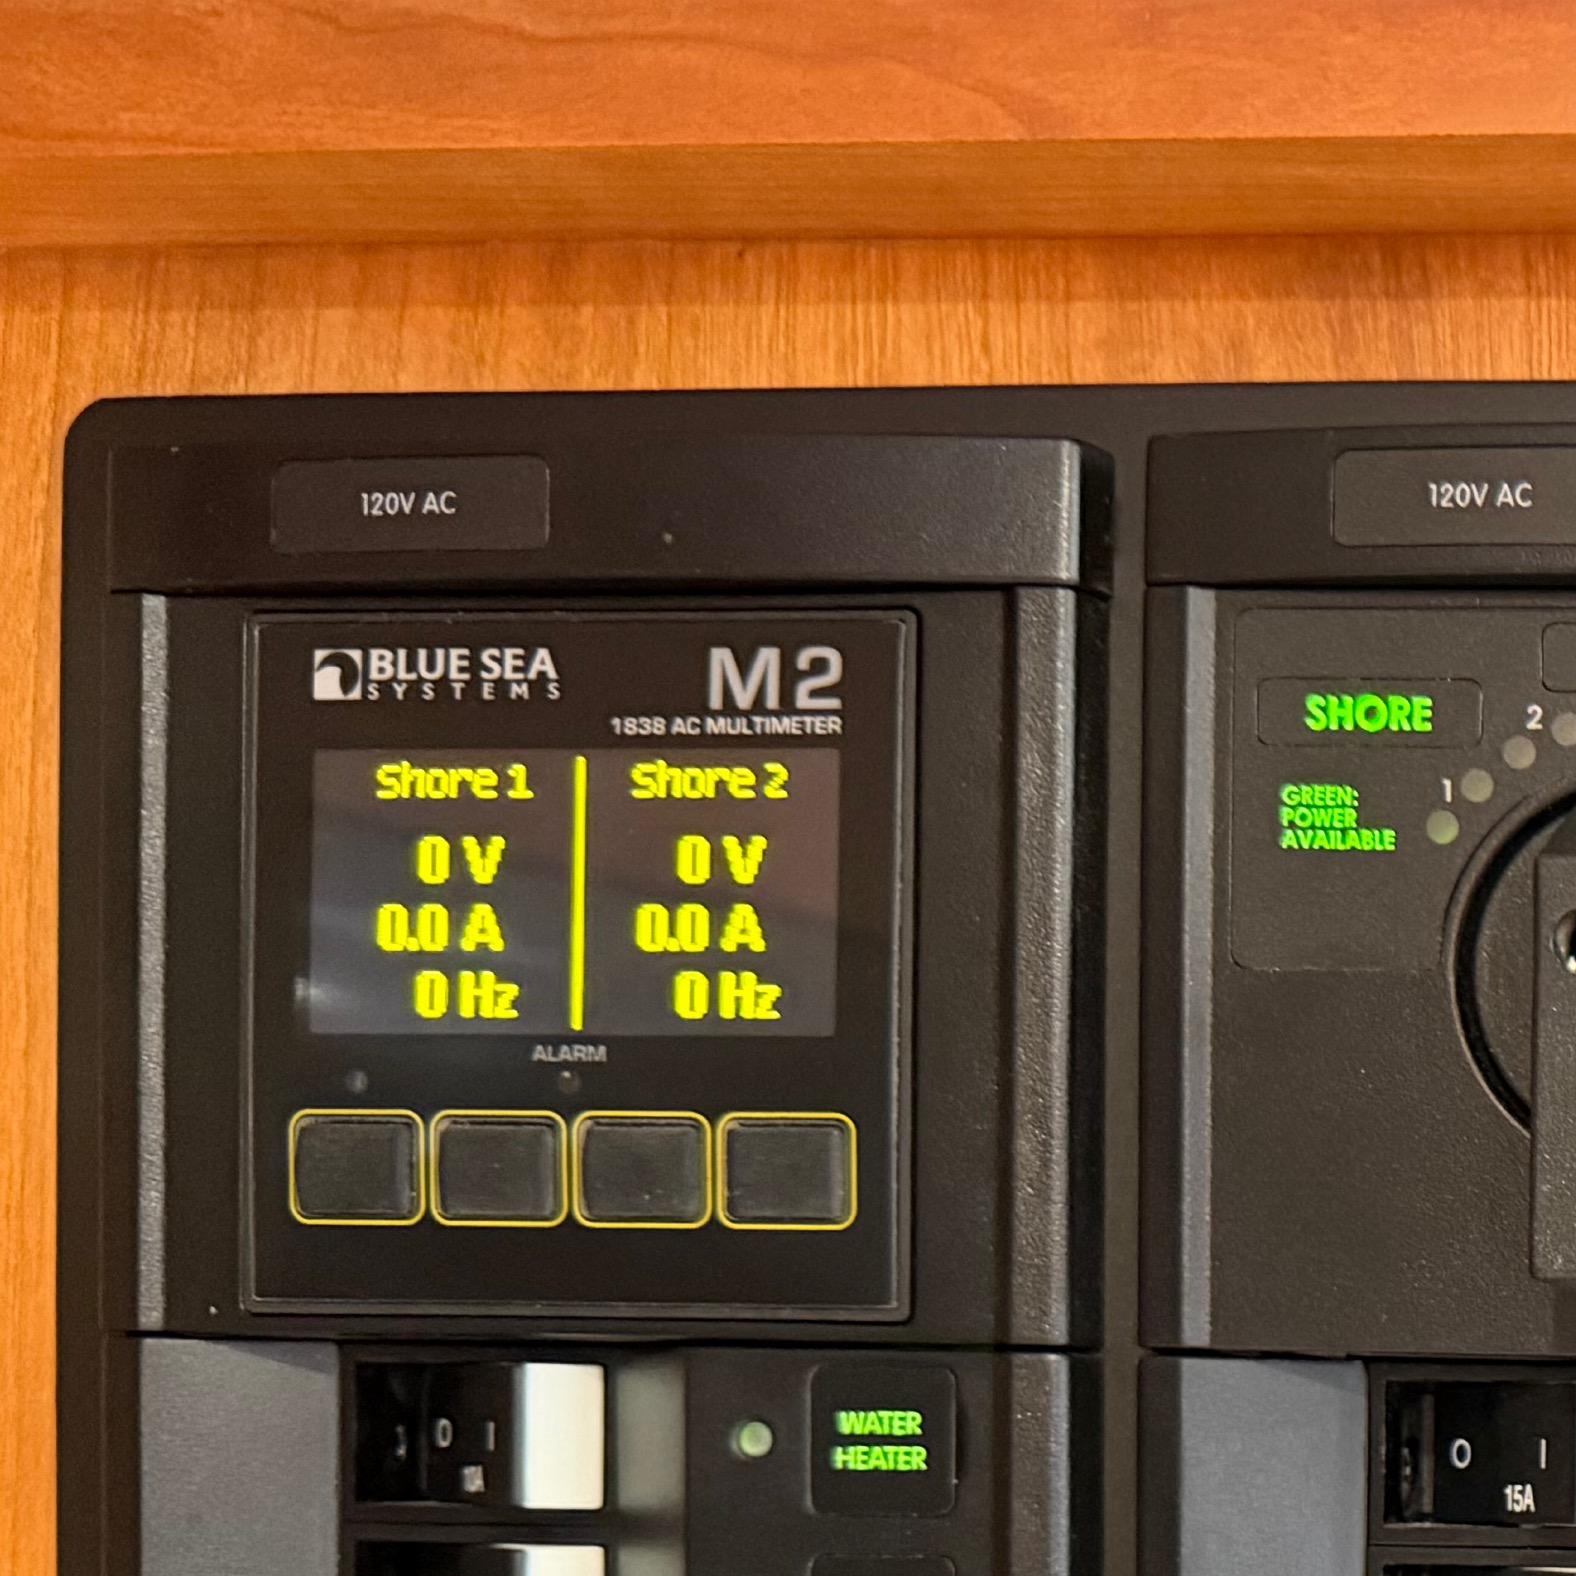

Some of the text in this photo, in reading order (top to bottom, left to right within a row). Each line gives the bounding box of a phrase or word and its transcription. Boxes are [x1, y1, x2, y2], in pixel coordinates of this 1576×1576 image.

[362, 491, 456, 515] 120V AC
[1429, 483, 1532, 507] 120V AC
[369, 648, 558, 680] BLUE SEA
[612, 716, 842, 735] 1838 AC MULTIMETER
[1305, 694, 1432, 732] SHORE
[1527, 705, 1542, 729] 2
[376, 761, 534, 799] Shore 1
[631, 760, 788, 798] Shore 2
[1443, 779, 1451, 802] 1
[1280, 784, 1358, 808] GREEN:
[1280, 808, 1357, 828] POWER
[1280, 829, 1395, 850] AVAILABLE
[417, 836, 505, 884] 0 V
[677, 835, 767, 884] 0 V
[376, 904, 504, 951] 0.0 A
[636, 904, 765, 952] 0.0 A
[414, 971, 519, 1018] 0 Hz
[674, 971, 781, 1019] 0 Hz
[533, 1045, 606, 1061] ALARM
[837, 1411, 922, 1436] WATER
[833, 1446, 927, 1470] HEATER
